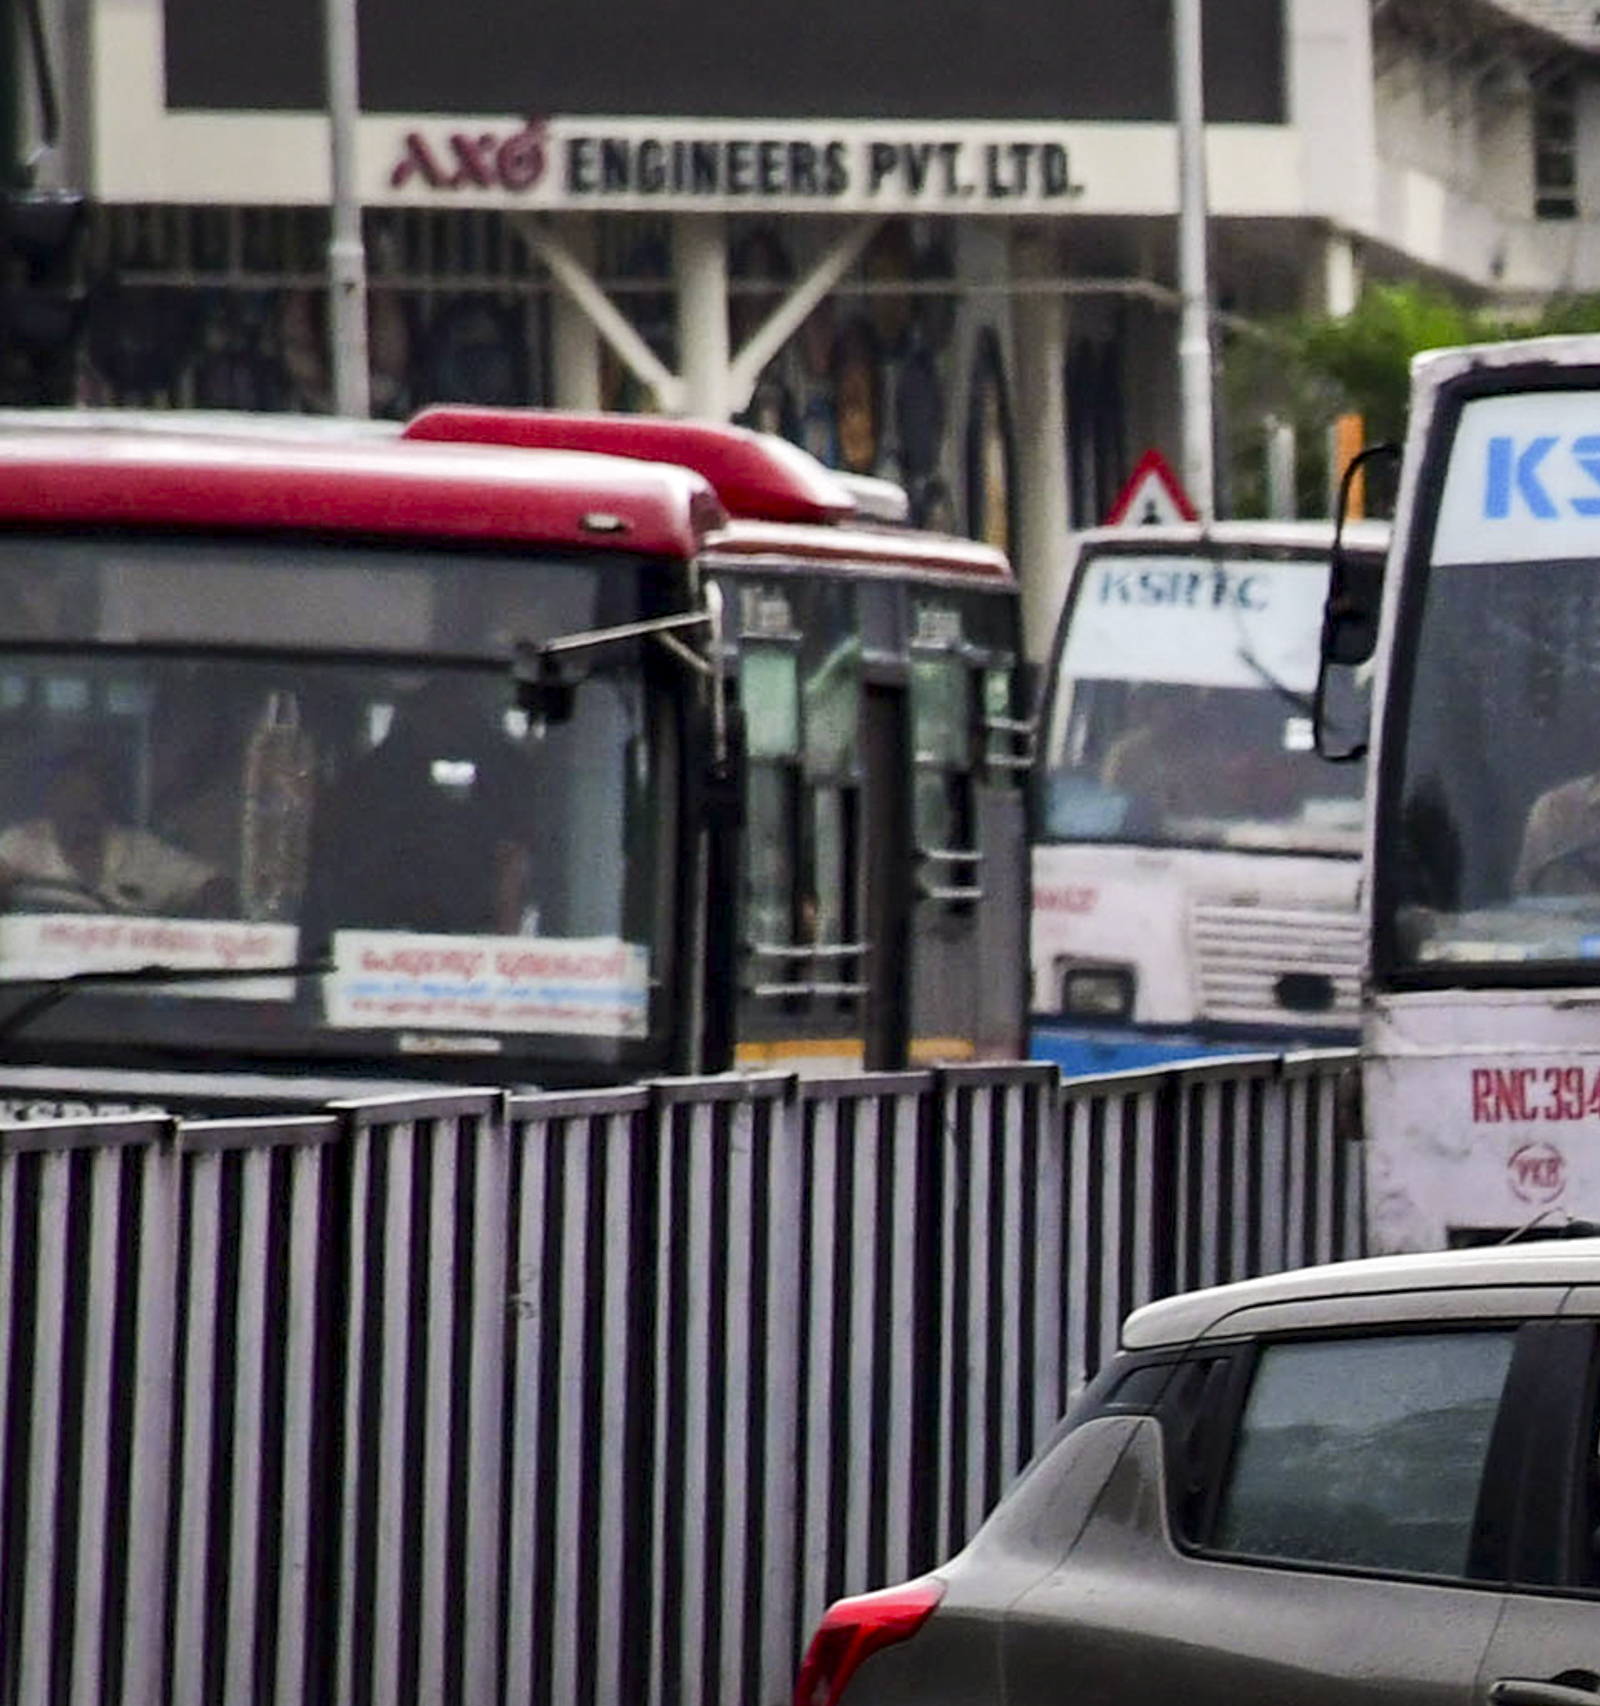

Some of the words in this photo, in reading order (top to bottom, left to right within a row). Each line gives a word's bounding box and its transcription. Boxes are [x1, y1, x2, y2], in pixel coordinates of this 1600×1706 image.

[564, 137, 848, 195] ENGINEERS
[985, 143, 1085, 198] LTD.
[1099, 569, 1270, 612] KSRTC
